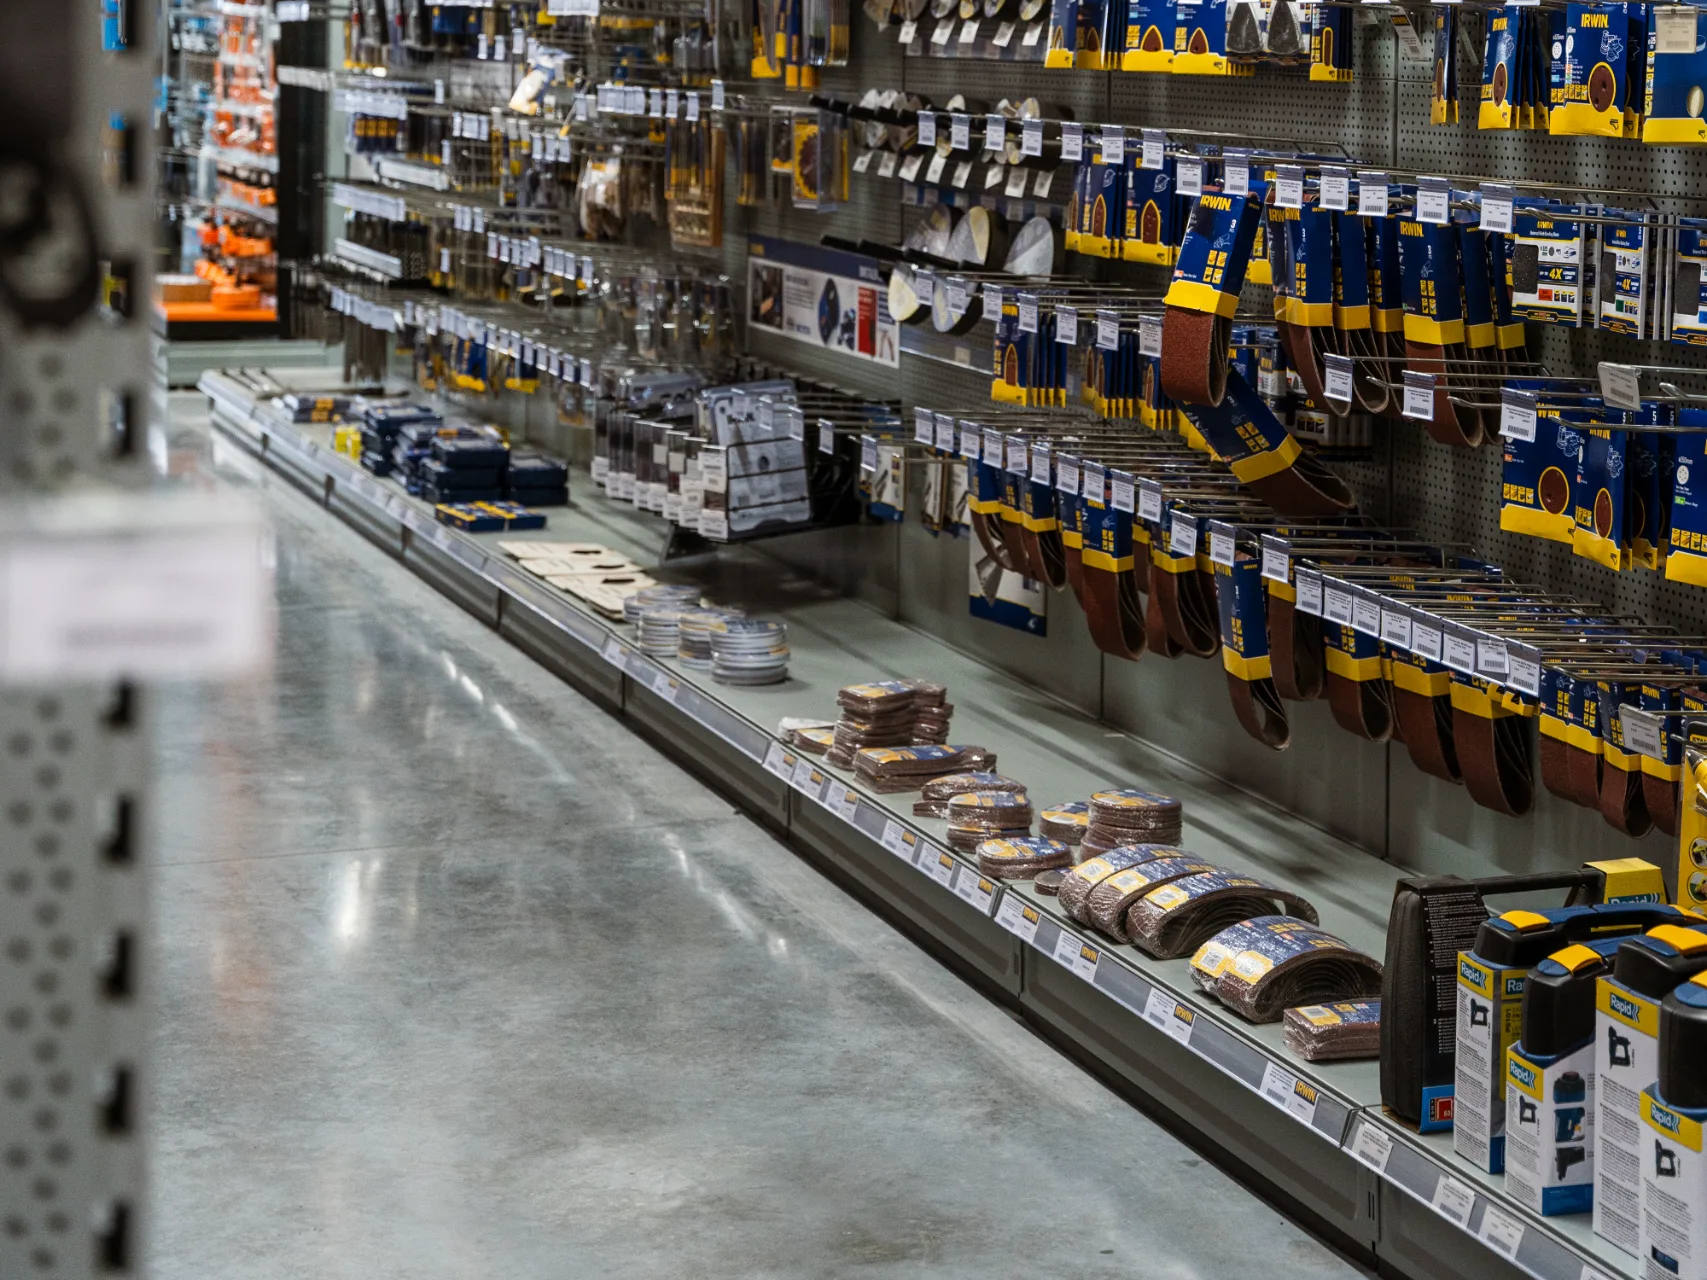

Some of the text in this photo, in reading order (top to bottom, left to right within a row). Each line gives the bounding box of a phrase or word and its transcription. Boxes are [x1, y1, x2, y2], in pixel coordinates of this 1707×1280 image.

[1581, 13, 1609, 28] IRWIN
[1200, 194, 1232, 212] IRWIN
[1269, 208, 1285, 222] IRW
[1400, 221, 1424, 237] IRWIN
[1549, 268, 1563, 280] 4X
[1641, 684, 1660, 700] IRWIN
[1684, 697, 1704, 711] IRWIN
[1461, 961, 1480, 986] Rapid
[1174, 1003, 1194, 1026] IRWIN
[1610, 995, 1633, 1017] Rapid
[1510, 1061, 1530, 1085] Rapid
[1295, 1080, 1316, 1103] IRWIN
[1651, 1104, 1673, 1130] Rapid
